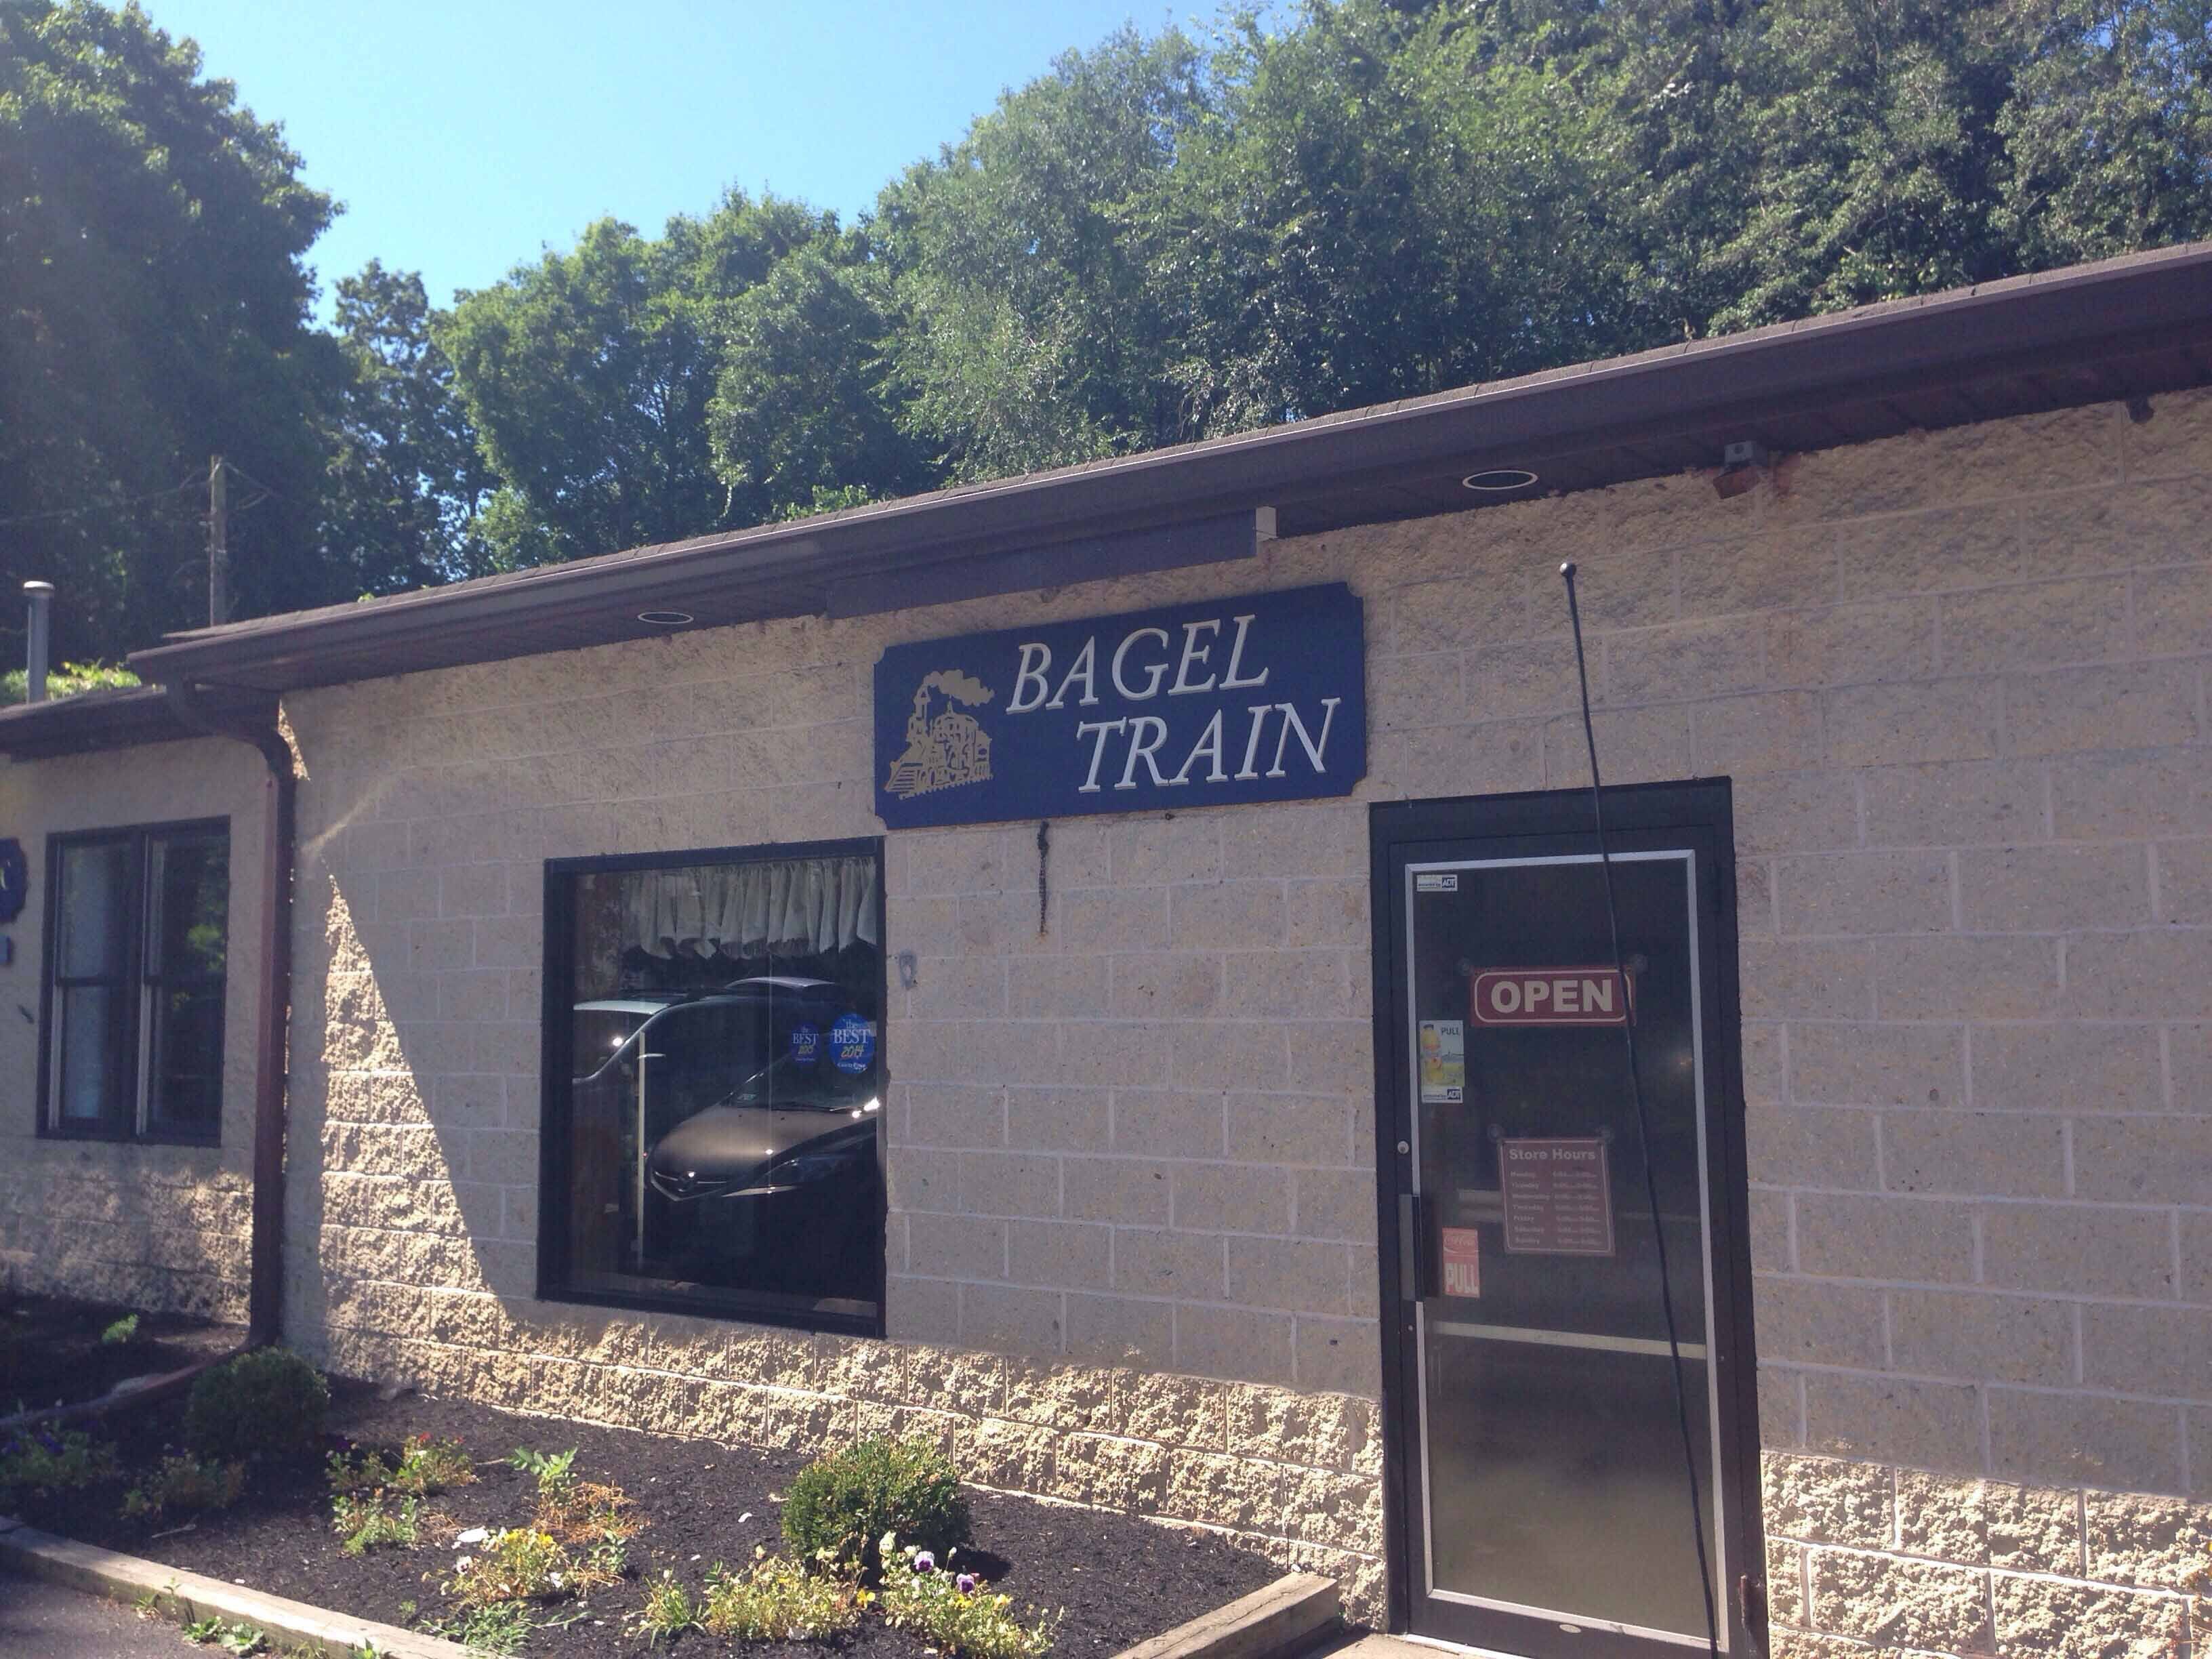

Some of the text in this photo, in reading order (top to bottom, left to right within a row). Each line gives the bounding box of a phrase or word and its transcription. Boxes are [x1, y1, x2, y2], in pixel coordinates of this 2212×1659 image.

[1006, 613, 1269, 715] BAGEL
[1076, 697, 1341, 793] TRAIN
[1442, 878, 1454, 887] ADT
[1491, 979, 1612, 1014] OPEN
[834, 1029, 871, 1044] BEST
[1441, 1026, 1461, 1036] PULL
[792, 1033, 819, 1045] BEST
[841, 1045, 864, 1059] 2014
[1448, 1090, 1460, 1099] ADT
[1509, 1149, 1596, 1160] Store Hours
